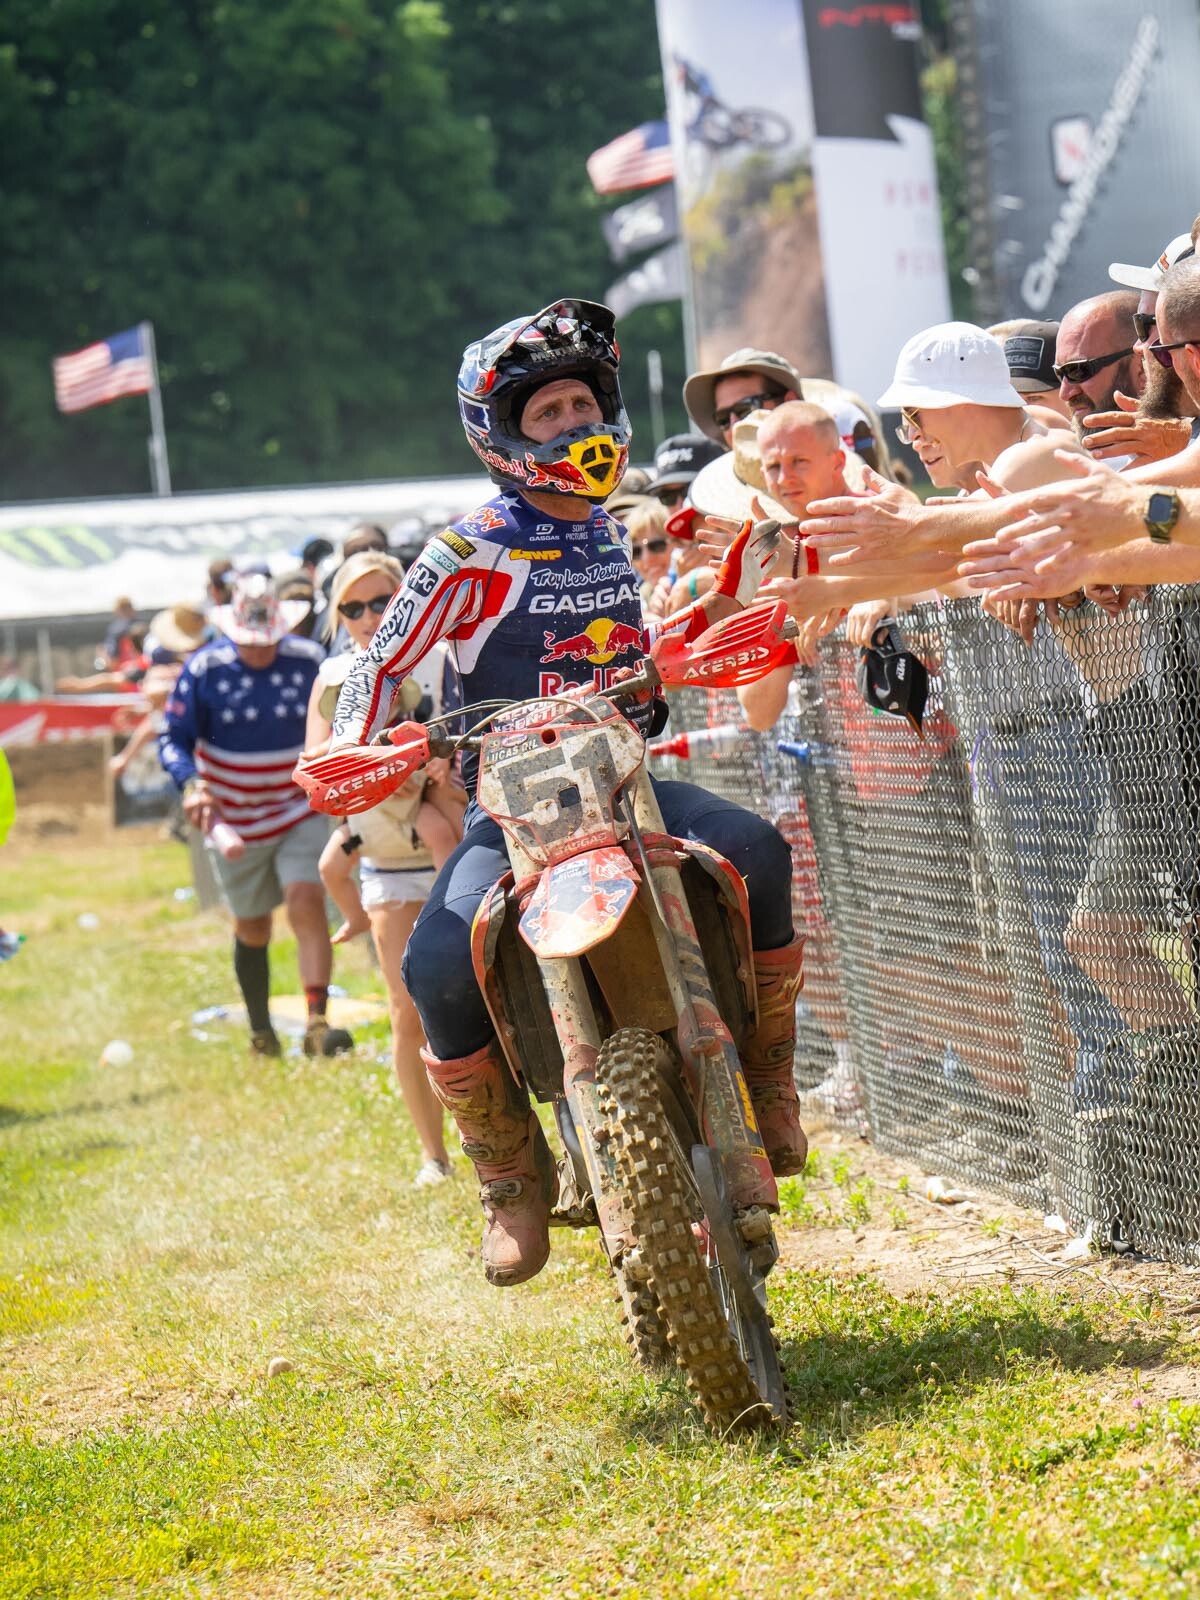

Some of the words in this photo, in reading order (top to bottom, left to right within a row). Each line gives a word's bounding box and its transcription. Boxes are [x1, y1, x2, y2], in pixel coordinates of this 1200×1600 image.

[409, 566, 436, 593] PPG
[530, 568, 563, 590] Troy
[564, 568, 588, 588] Lee
[528, 583, 640, 614] GASGAS
[486, 746, 519, 763] LUCAS
[497, 732, 618, 848] 51
